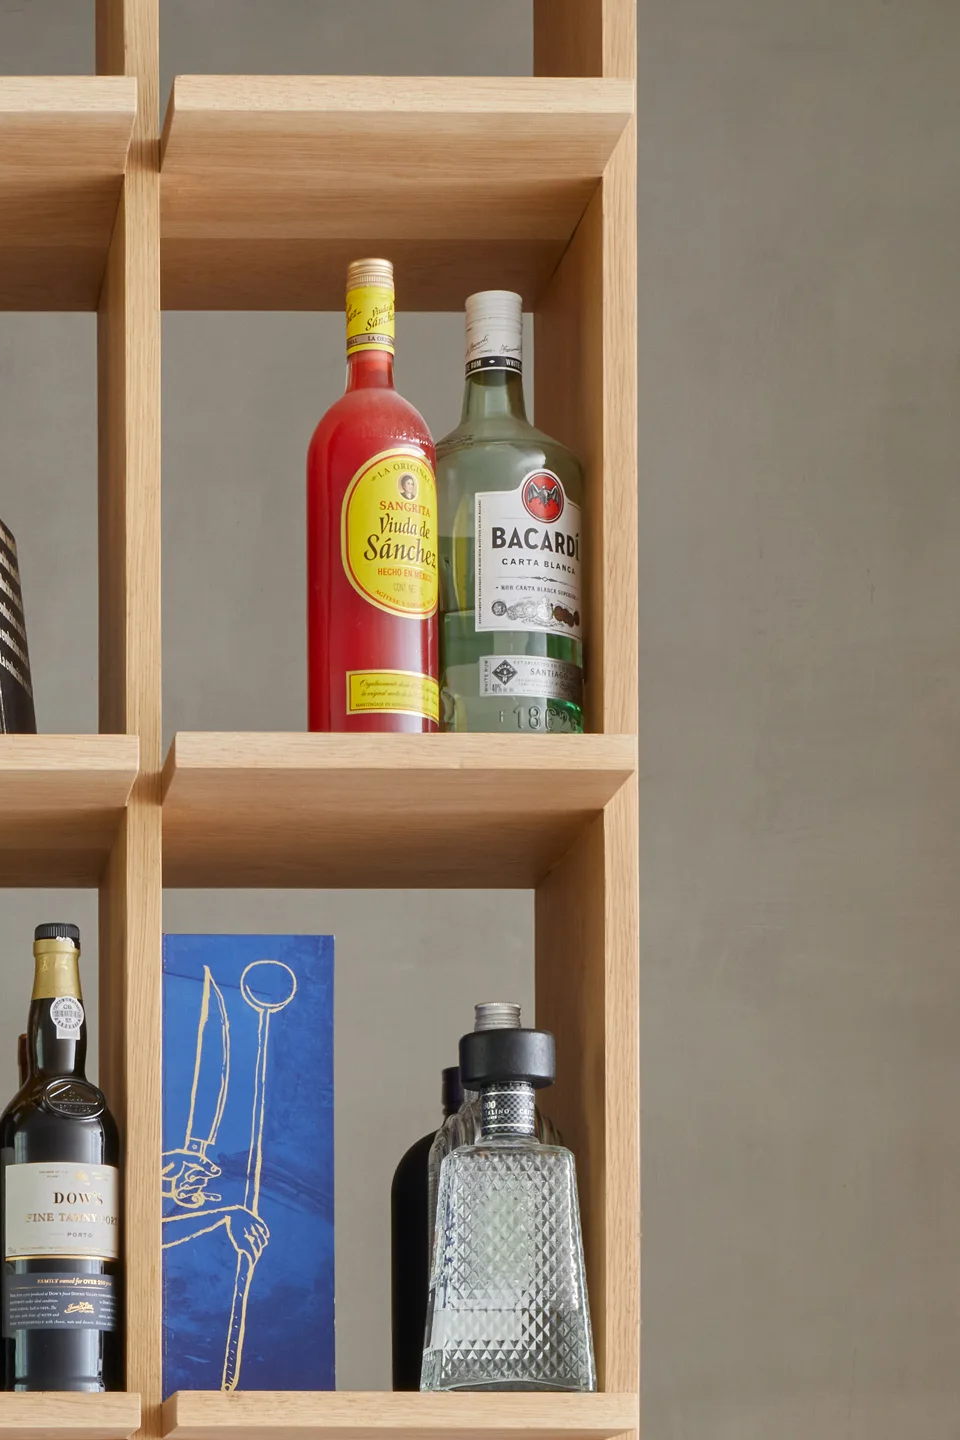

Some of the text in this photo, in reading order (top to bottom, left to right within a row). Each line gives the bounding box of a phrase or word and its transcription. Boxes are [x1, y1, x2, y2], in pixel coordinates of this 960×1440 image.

[380, 500, 430, 518] SANGRITA
[378, 513, 430, 540] Viuda de
[364, 534, 436, 568] Sánchez
[492, 526, 580, 562] BACARDÍ
[502, 558, 576, 576] CARTA BLANCA
